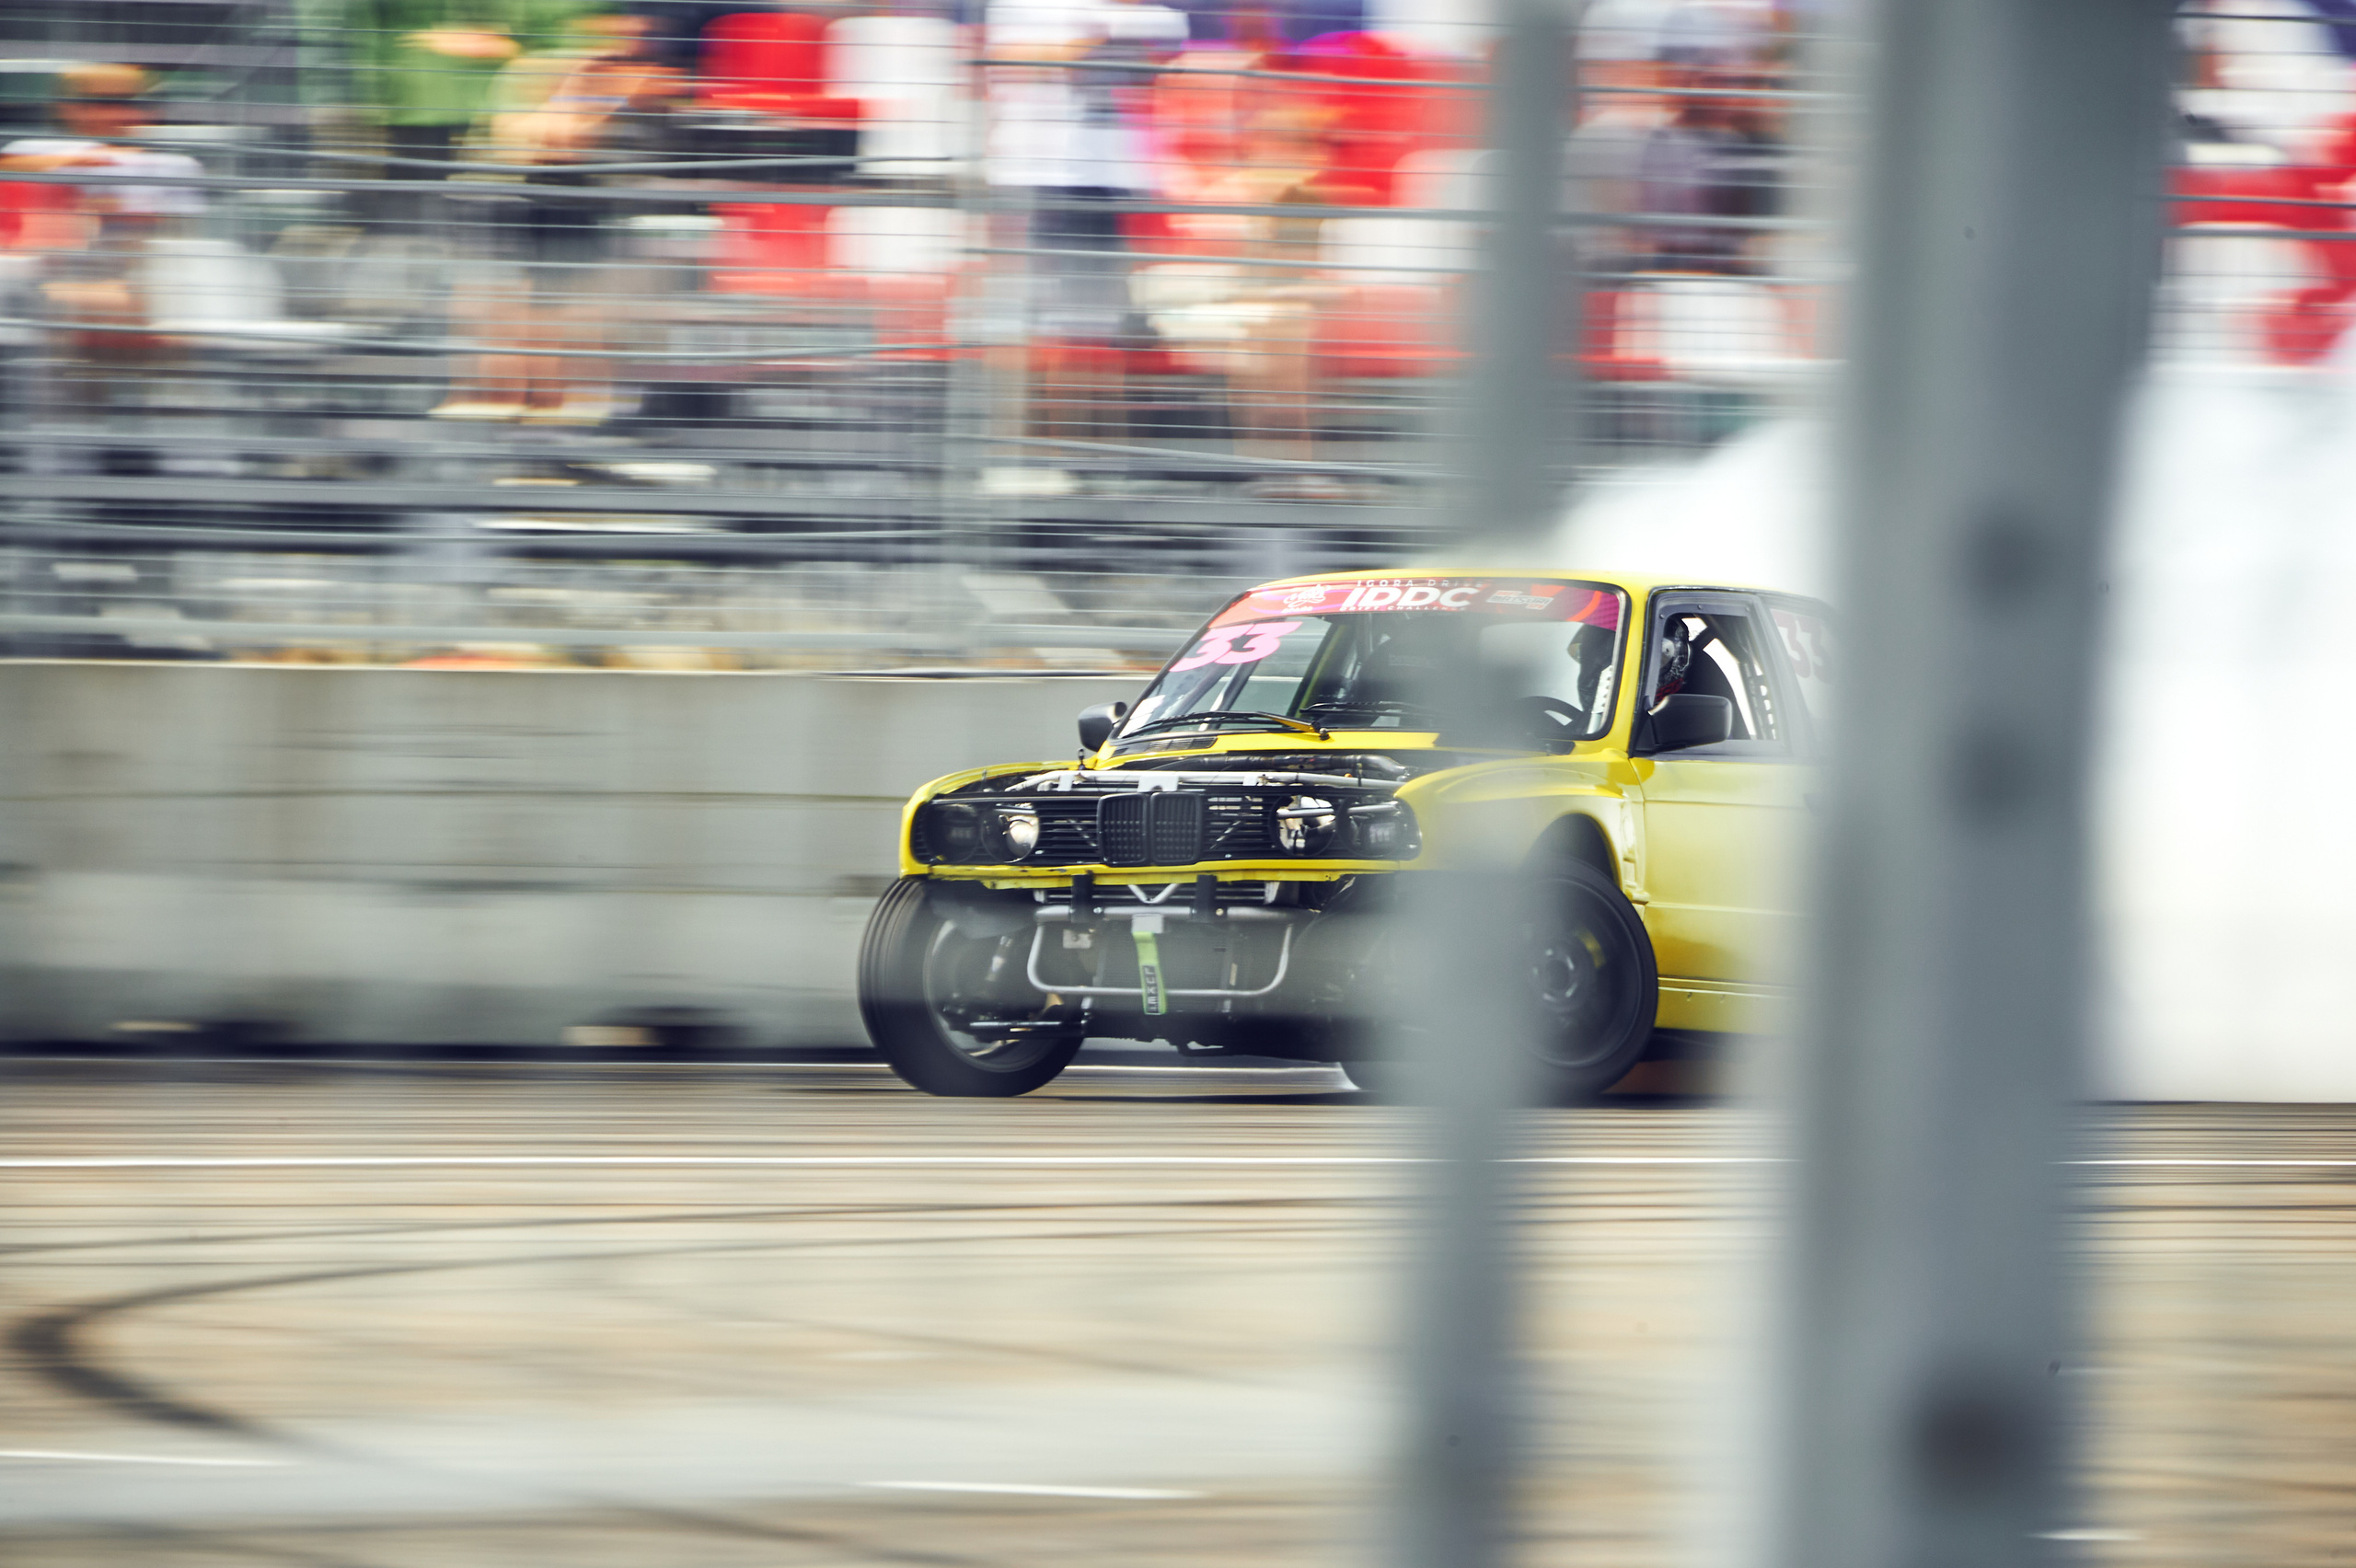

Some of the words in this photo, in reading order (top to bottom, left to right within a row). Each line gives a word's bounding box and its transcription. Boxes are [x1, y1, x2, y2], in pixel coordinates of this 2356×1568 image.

[1357, 579, 1414, 587] IGORA
[1427, 579, 1484, 588] DRIVE
[1341, 586, 1480, 607] IDDC
[1169, 621, 1303, 672] 33
